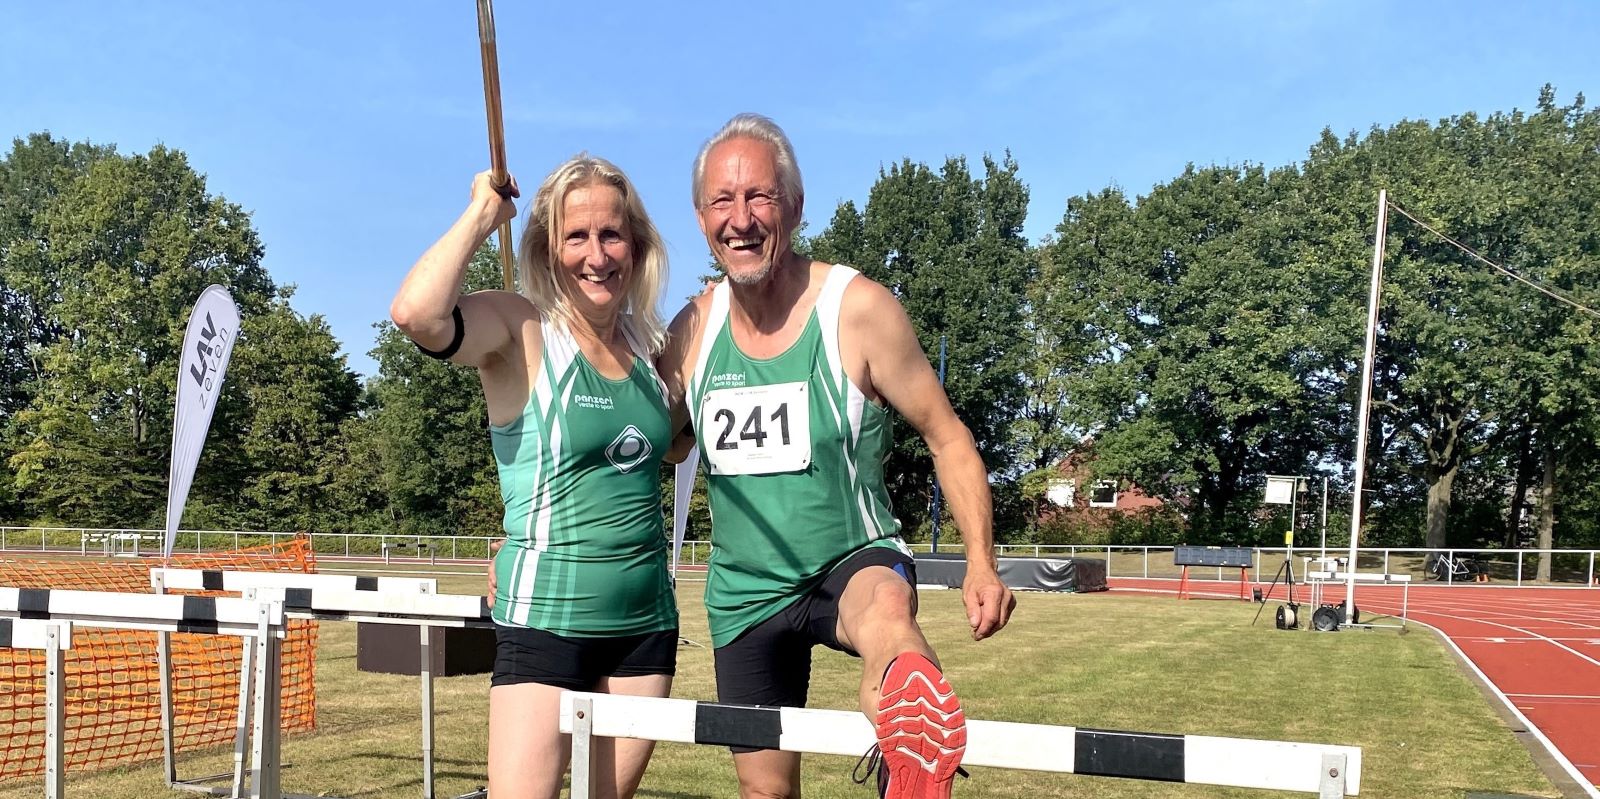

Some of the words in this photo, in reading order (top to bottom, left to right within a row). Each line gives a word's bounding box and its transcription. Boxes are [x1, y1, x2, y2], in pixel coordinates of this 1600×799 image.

[190, 311, 217, 387] LAV
[199, 328, 228, 410] zeven
[574, 394, 614, 405] panzeri
[711, 371, 746, 384] panzeri
[714, 402, 791, 451] 241
